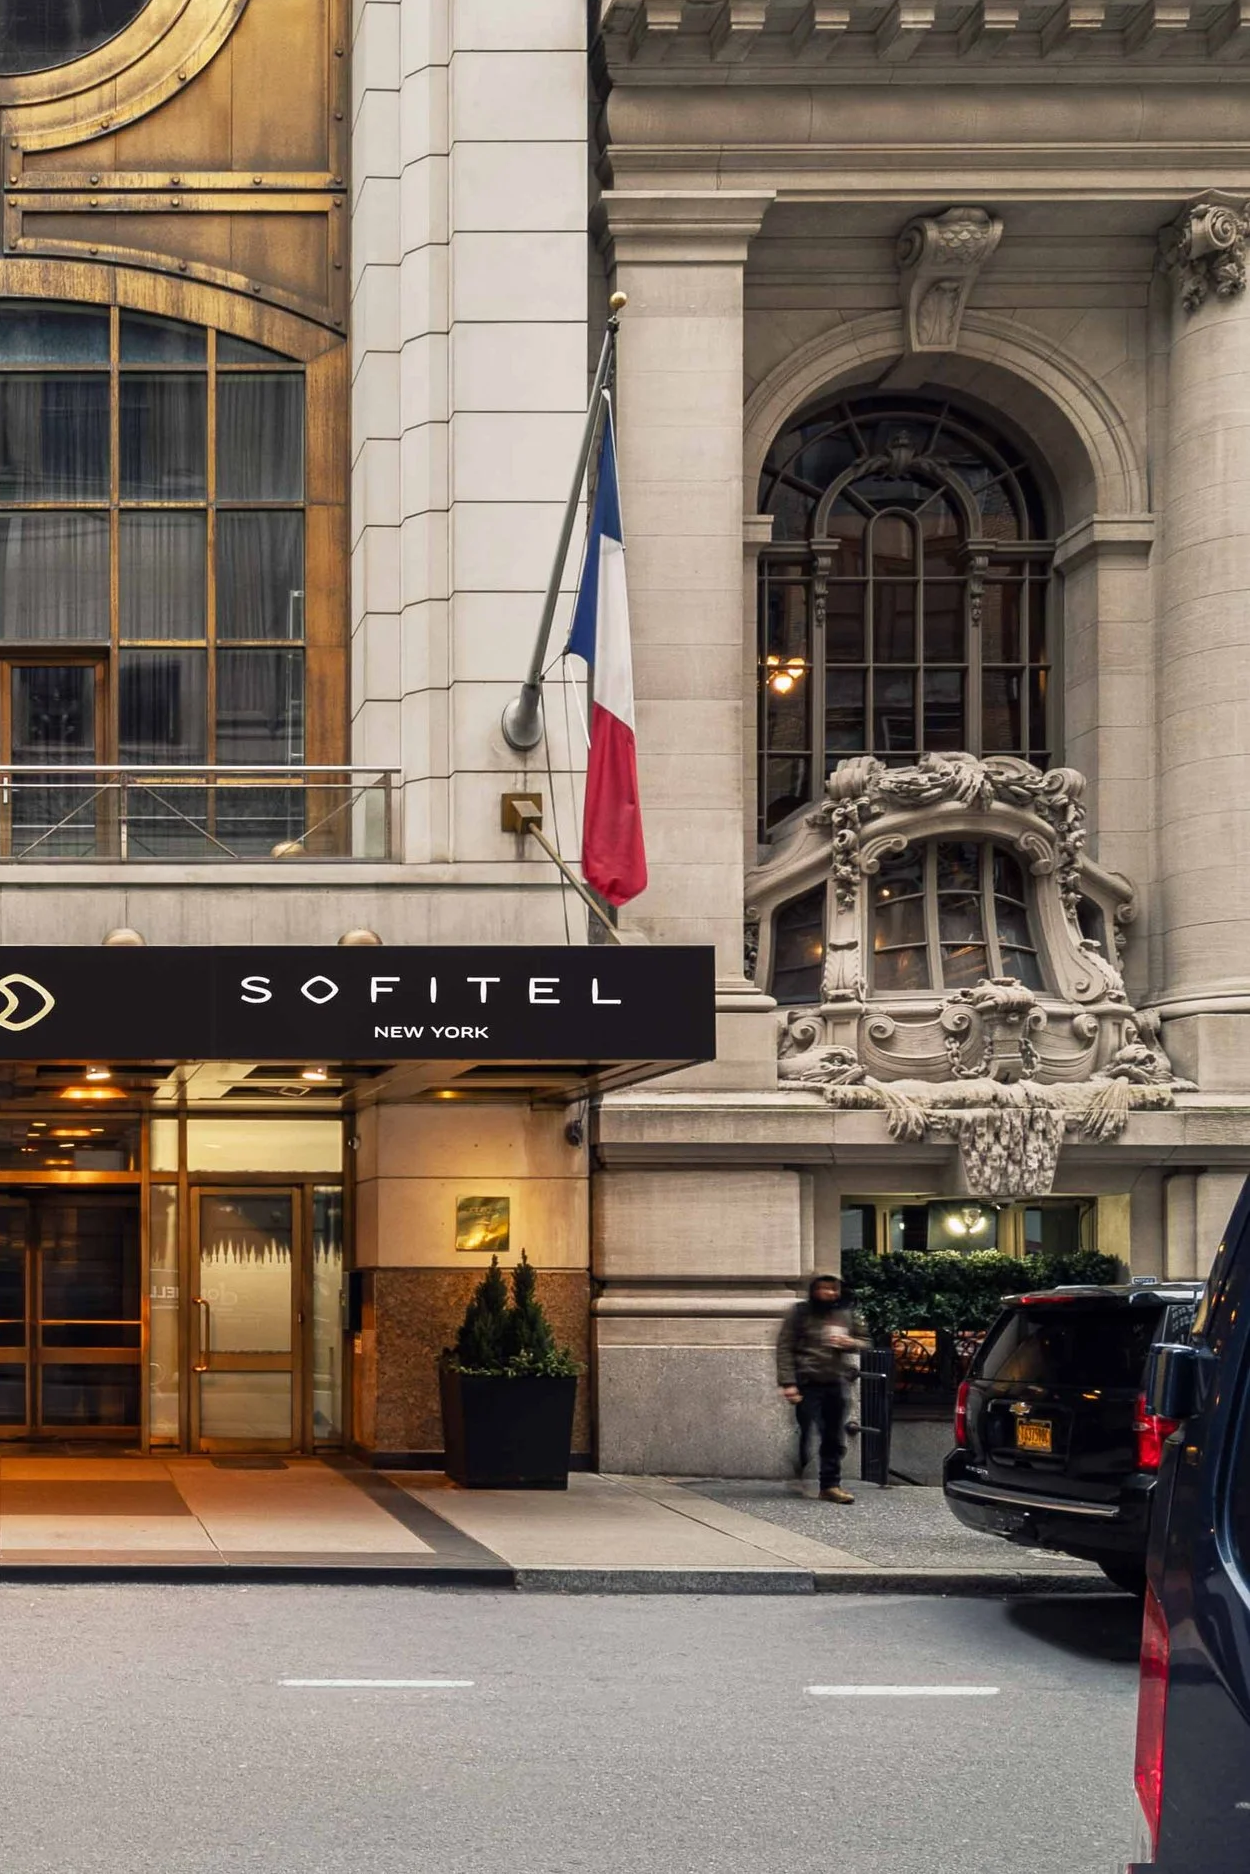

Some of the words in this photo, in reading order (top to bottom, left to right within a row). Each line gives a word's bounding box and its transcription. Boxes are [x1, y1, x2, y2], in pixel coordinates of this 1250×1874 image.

[240, 975, 622, 1005] SOFITEL
[374, 1026, 425, 1039] NEW
[430, 1026, 489, 1039] YORK
